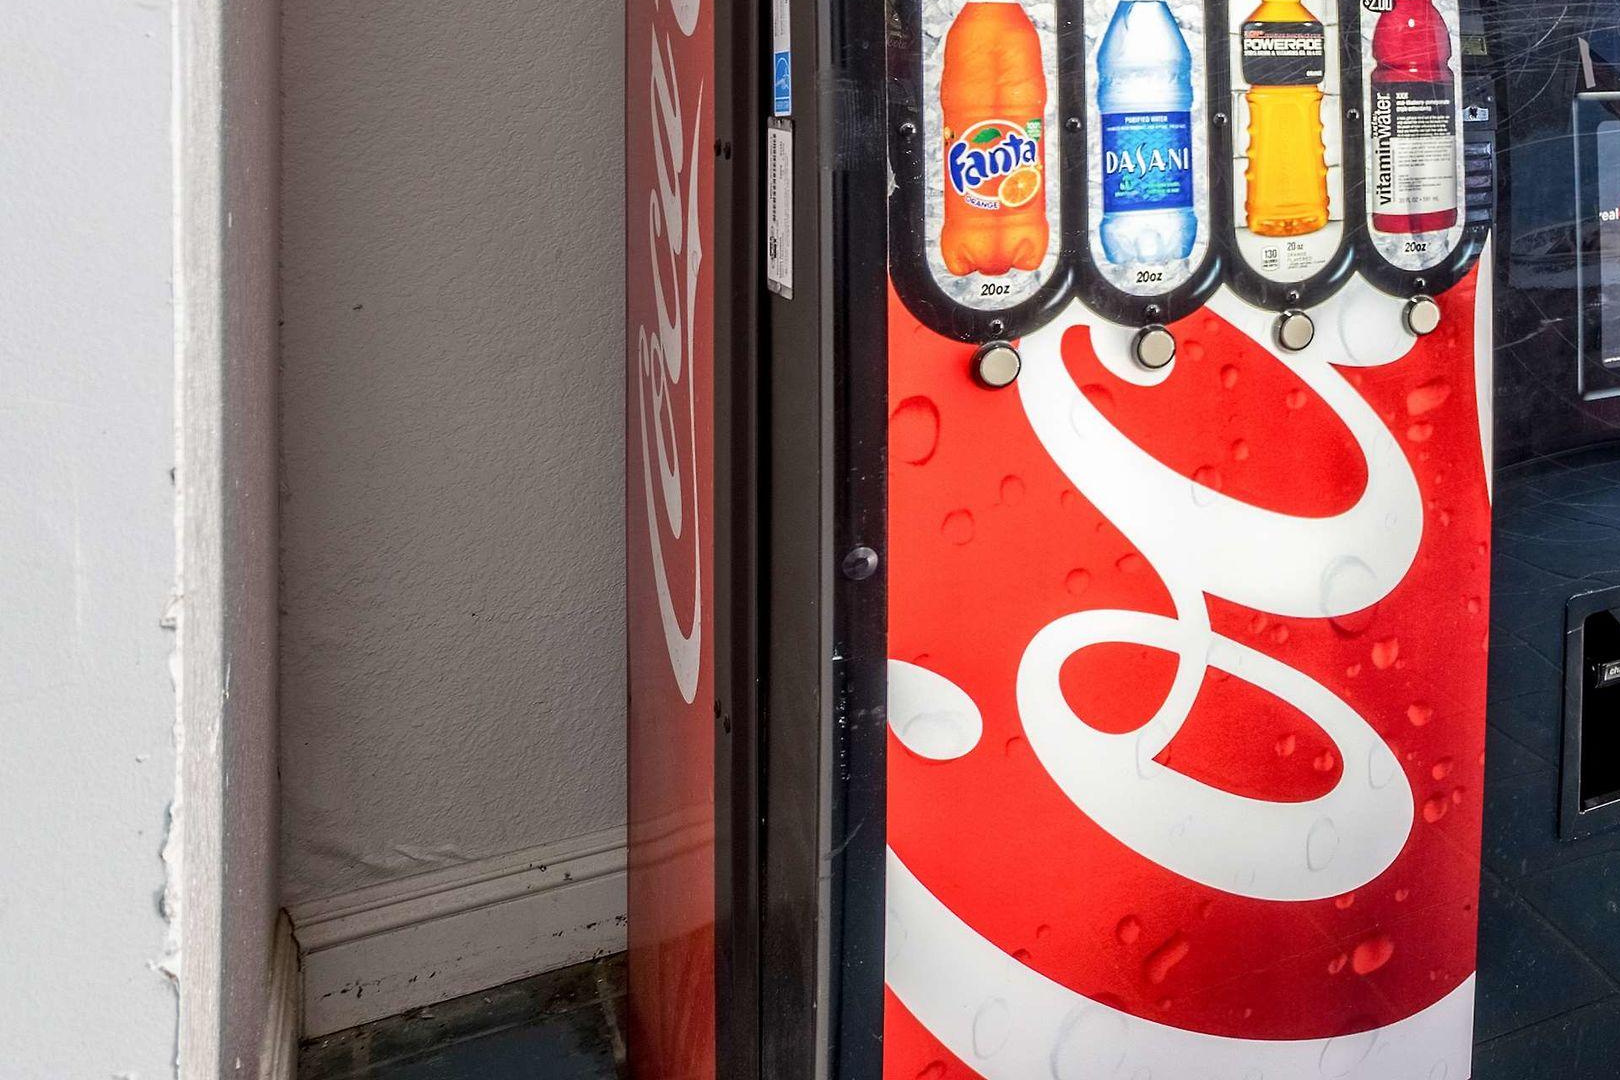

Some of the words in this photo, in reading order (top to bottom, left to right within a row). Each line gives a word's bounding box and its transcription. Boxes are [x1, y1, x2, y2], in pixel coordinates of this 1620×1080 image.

[1244, 38, 1322, 50] POWERADE
[949, 133, 1037, 193] Fanta
[1106, 142, 1189, 179] DASANI
[965, 195, 999, 209] ORANGE
[1264, 249, 1277, 259] 130
[1404, 241, 1426, 254] 20oz
[1136, 270, 1163, 284] 20oz
[980, 283, 1011, 297] 20oz
